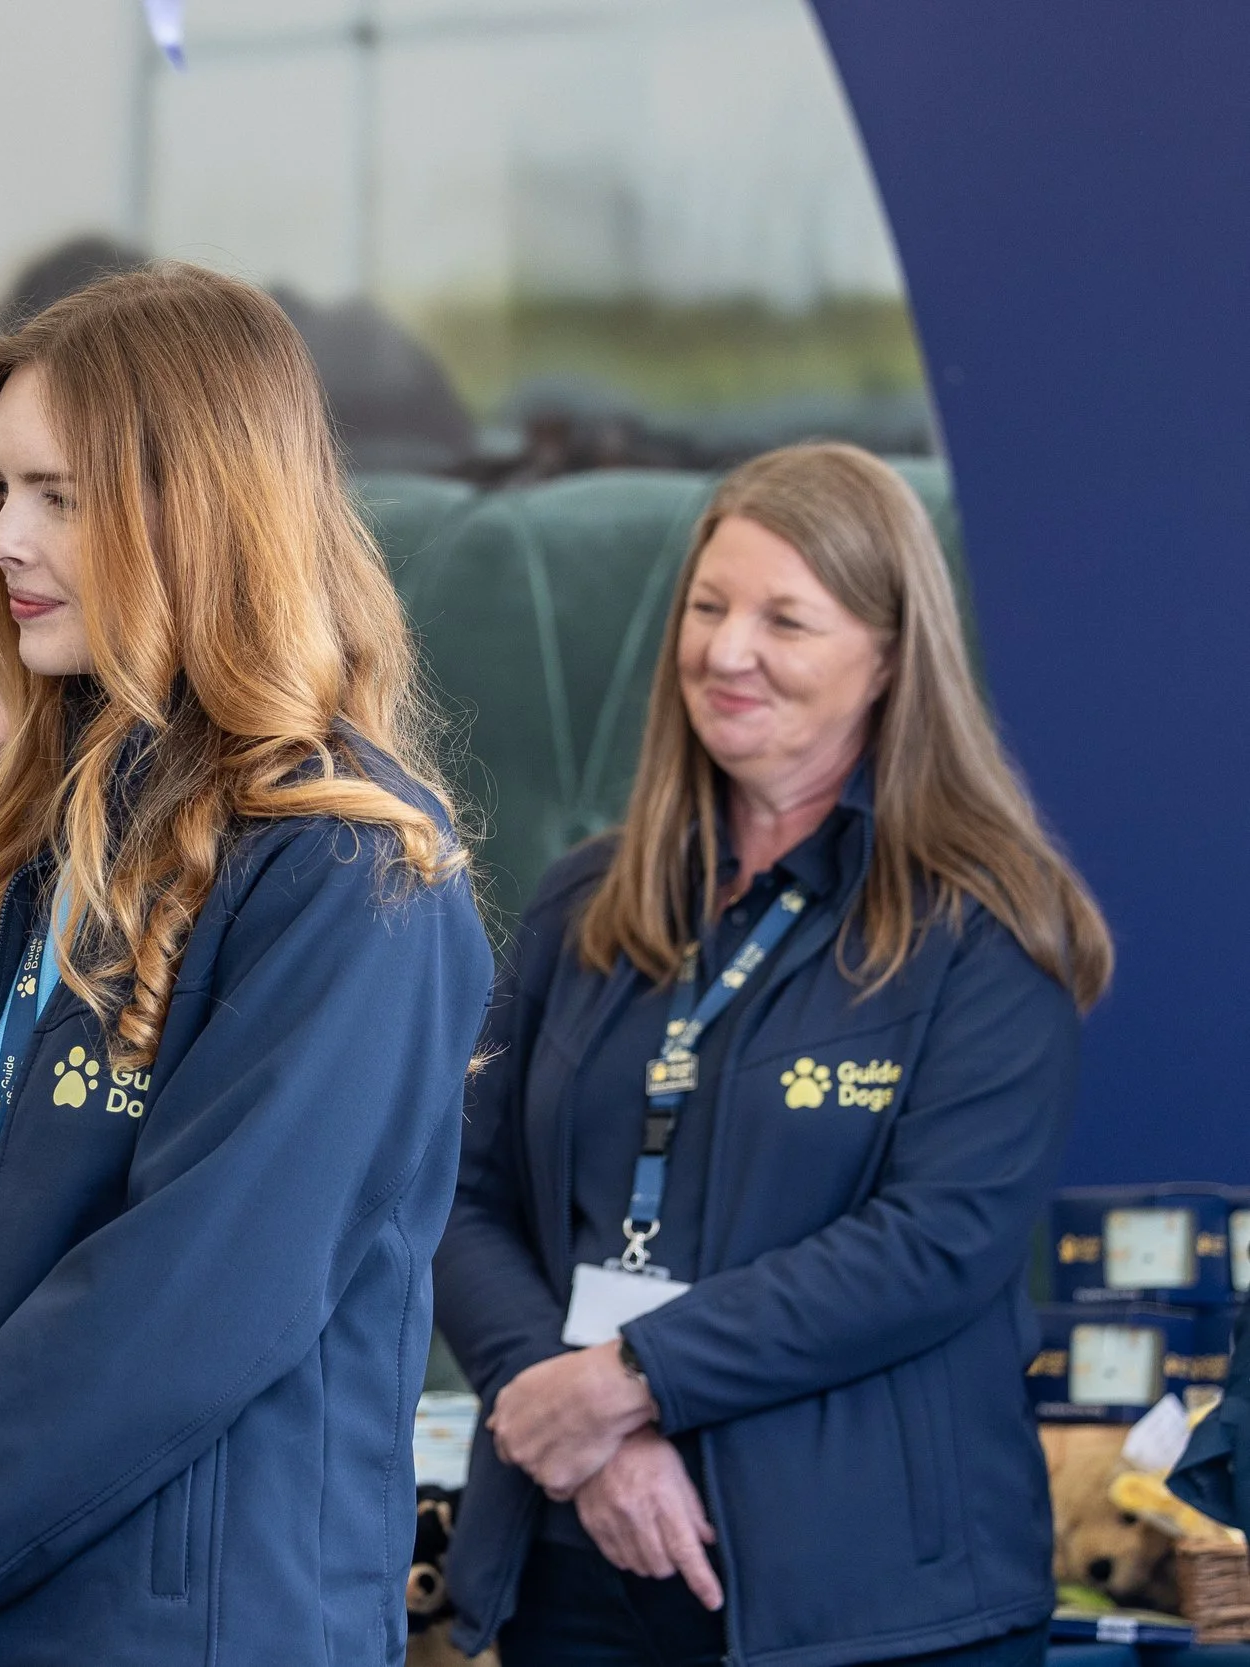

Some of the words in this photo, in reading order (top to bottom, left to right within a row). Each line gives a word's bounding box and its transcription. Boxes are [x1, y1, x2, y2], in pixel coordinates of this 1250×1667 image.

[23, 938, 37, 970] Guide
[837, 1059, 902, 1084] Guide
[838, 1084, 894, 1112] Dogs
